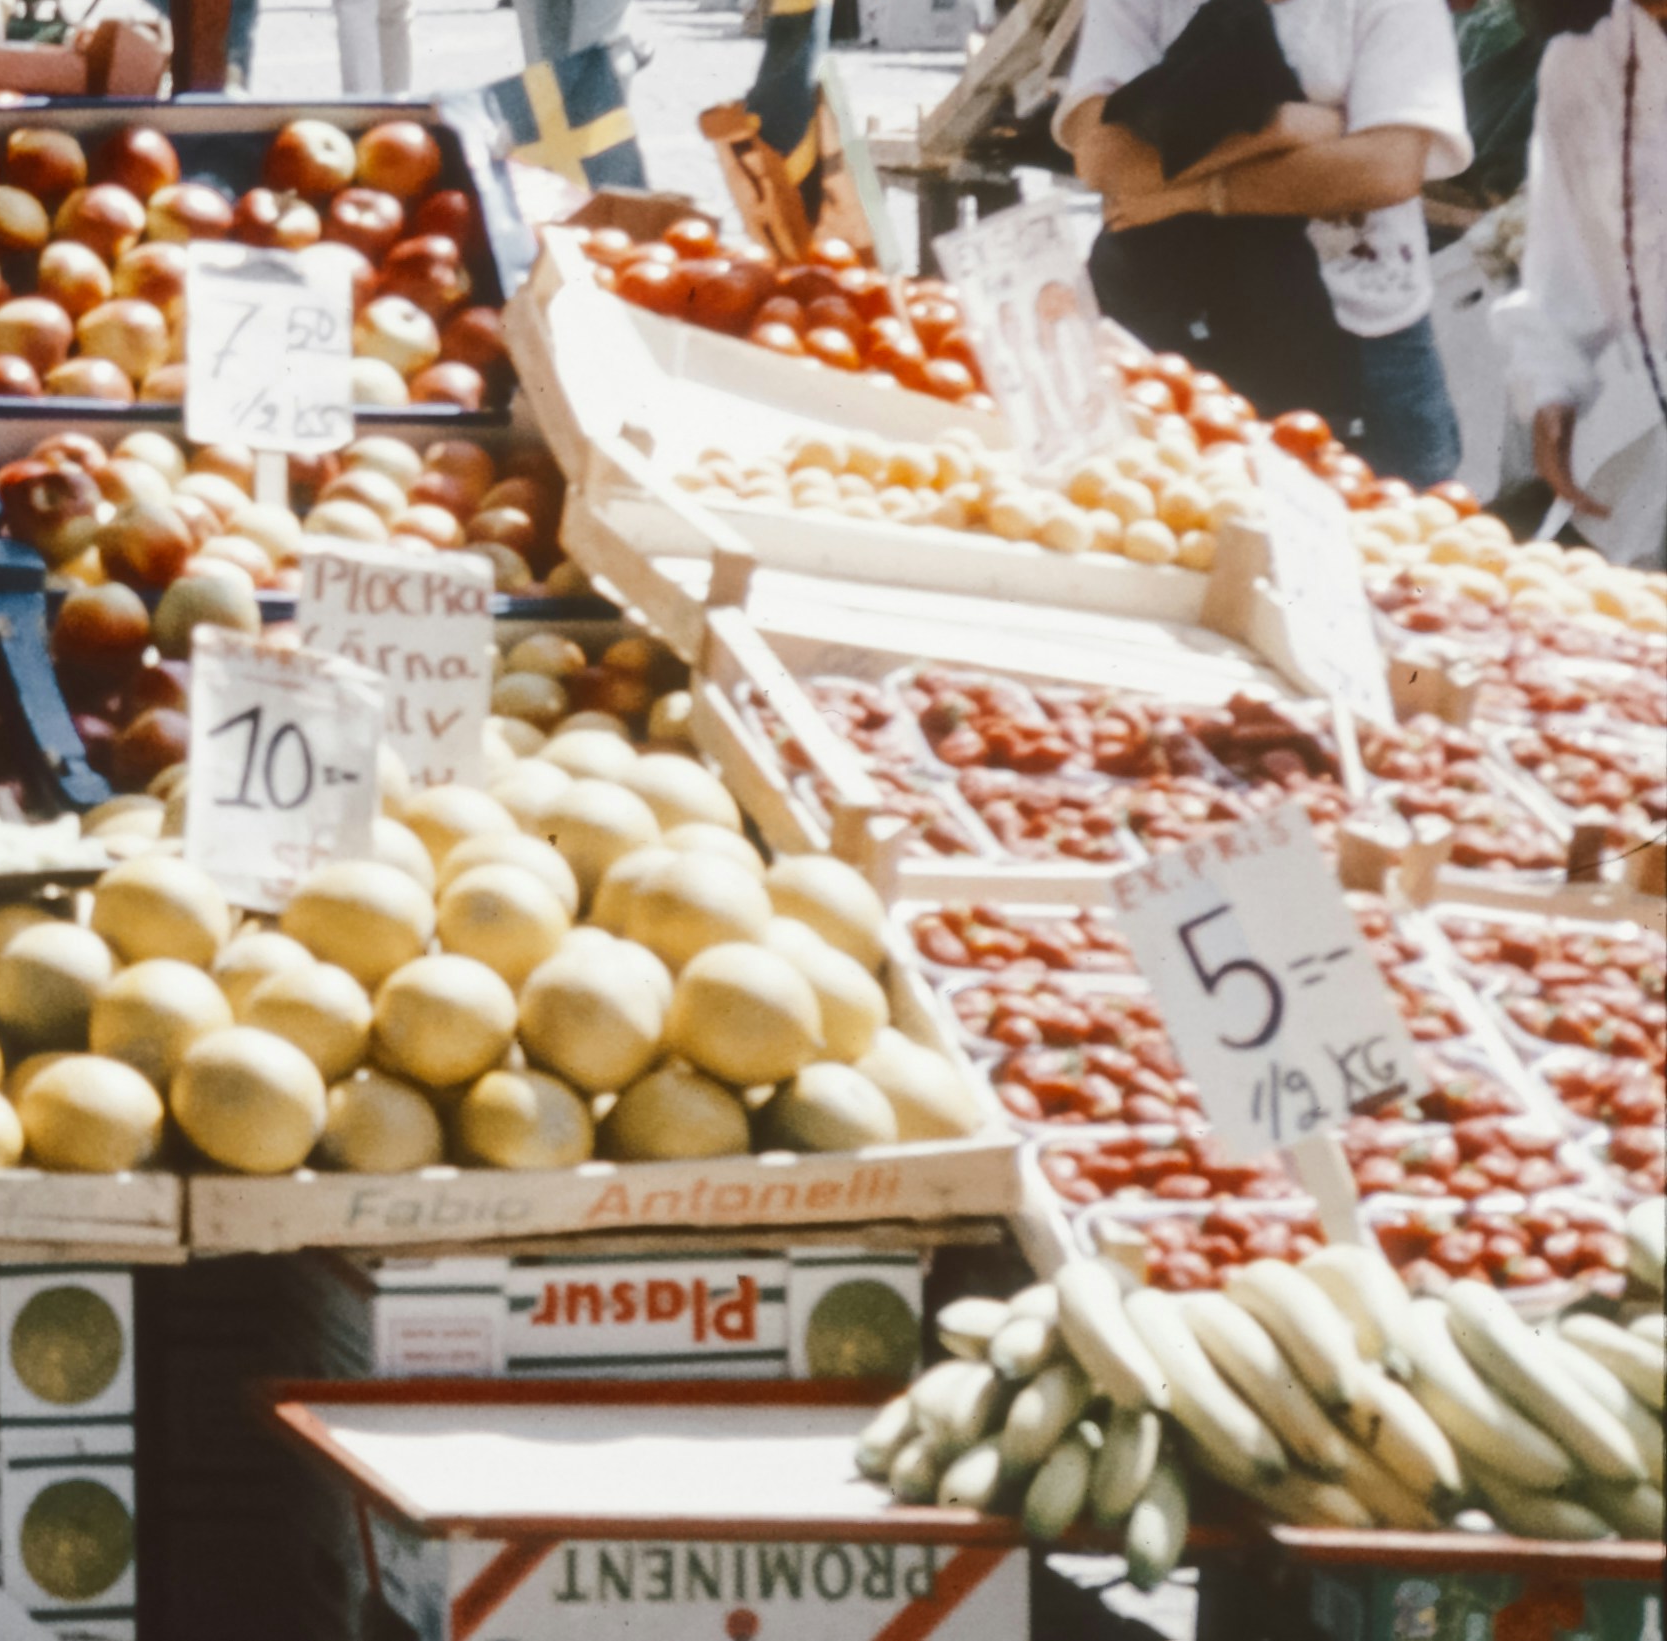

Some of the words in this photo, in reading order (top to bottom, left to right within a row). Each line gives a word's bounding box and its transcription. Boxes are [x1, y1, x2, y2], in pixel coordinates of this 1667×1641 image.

[344, 1187, 533, 1229] Fabio
[583, 1167, 903, 1227] Antonelli
[530, 1275, 760, 1343] Plasur
[553, 1542, 938, 1603] PROMINENT
